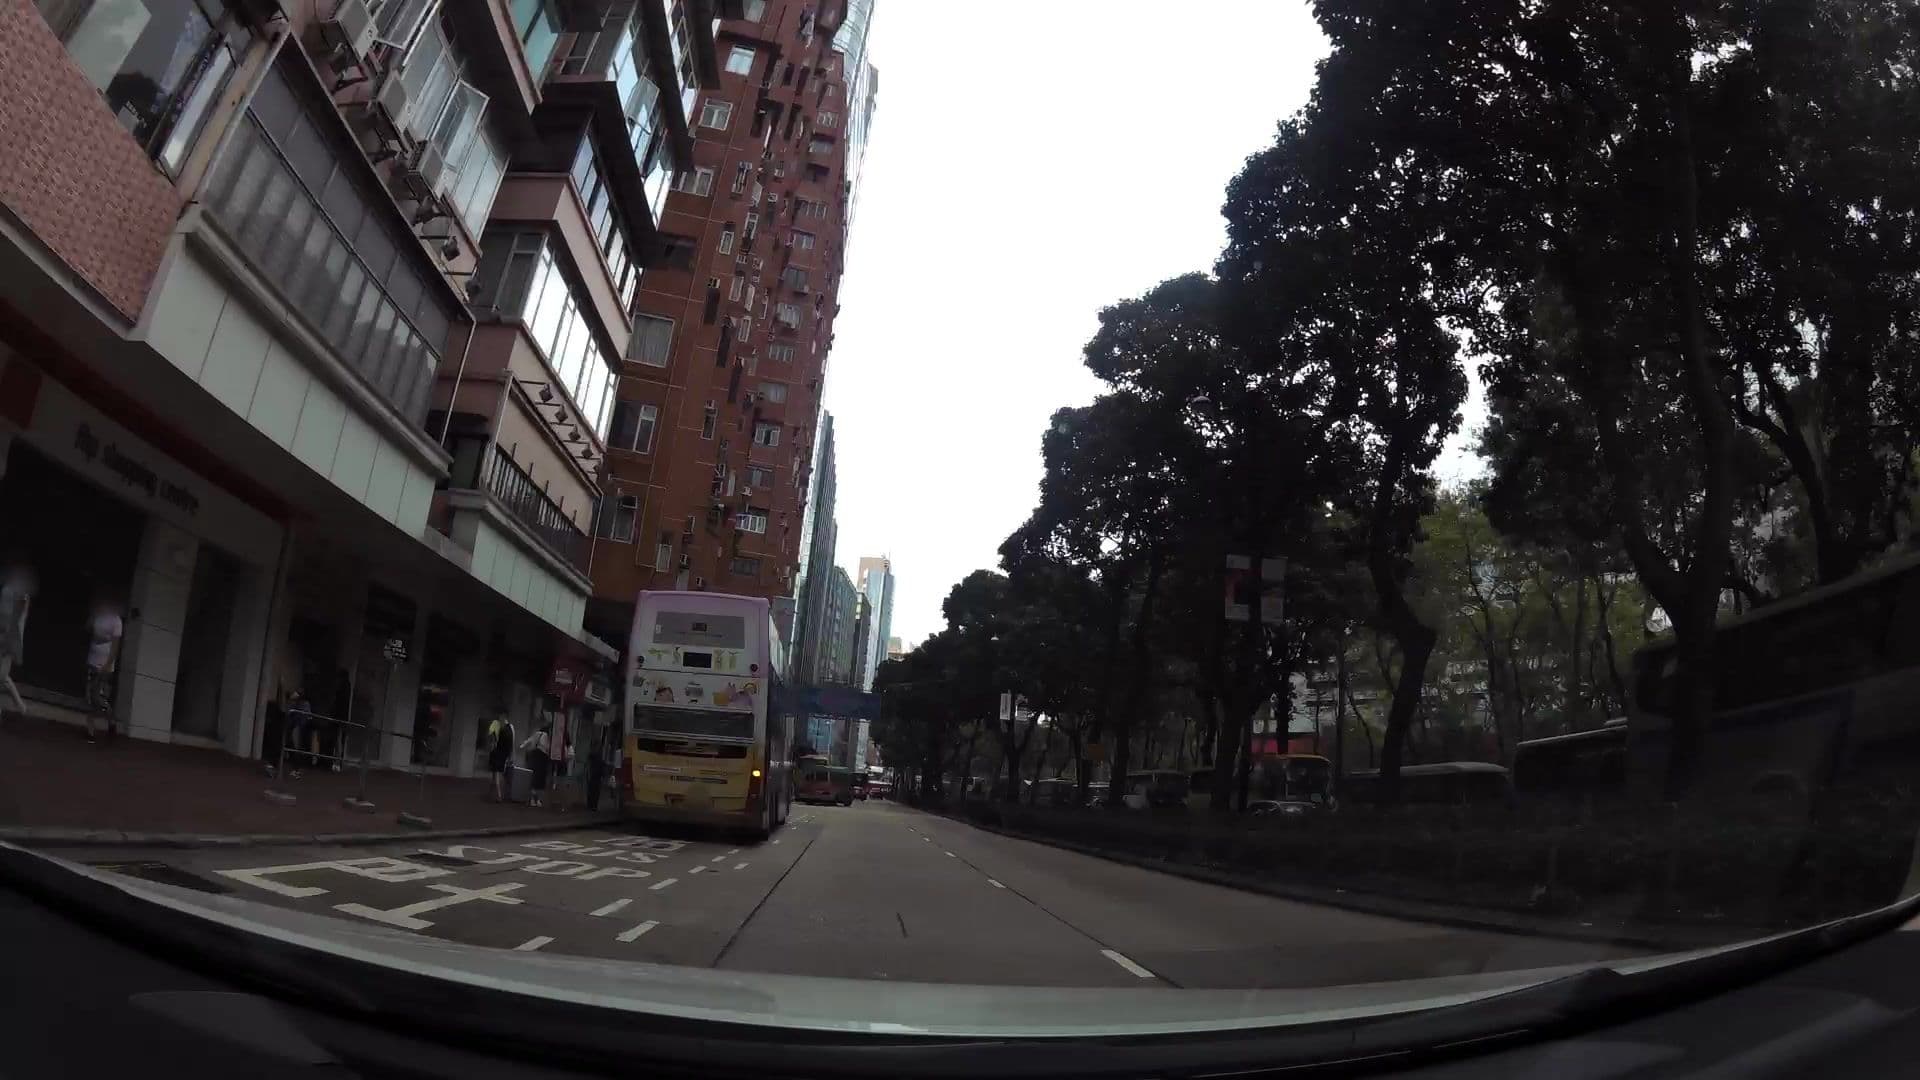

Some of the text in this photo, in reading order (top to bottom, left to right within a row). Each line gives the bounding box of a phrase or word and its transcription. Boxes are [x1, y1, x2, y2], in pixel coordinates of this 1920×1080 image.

[417, 845, 651, 880] STOP
[520, 840, 669, 863] BUS
[213, 857, 526, 930] 巴士
